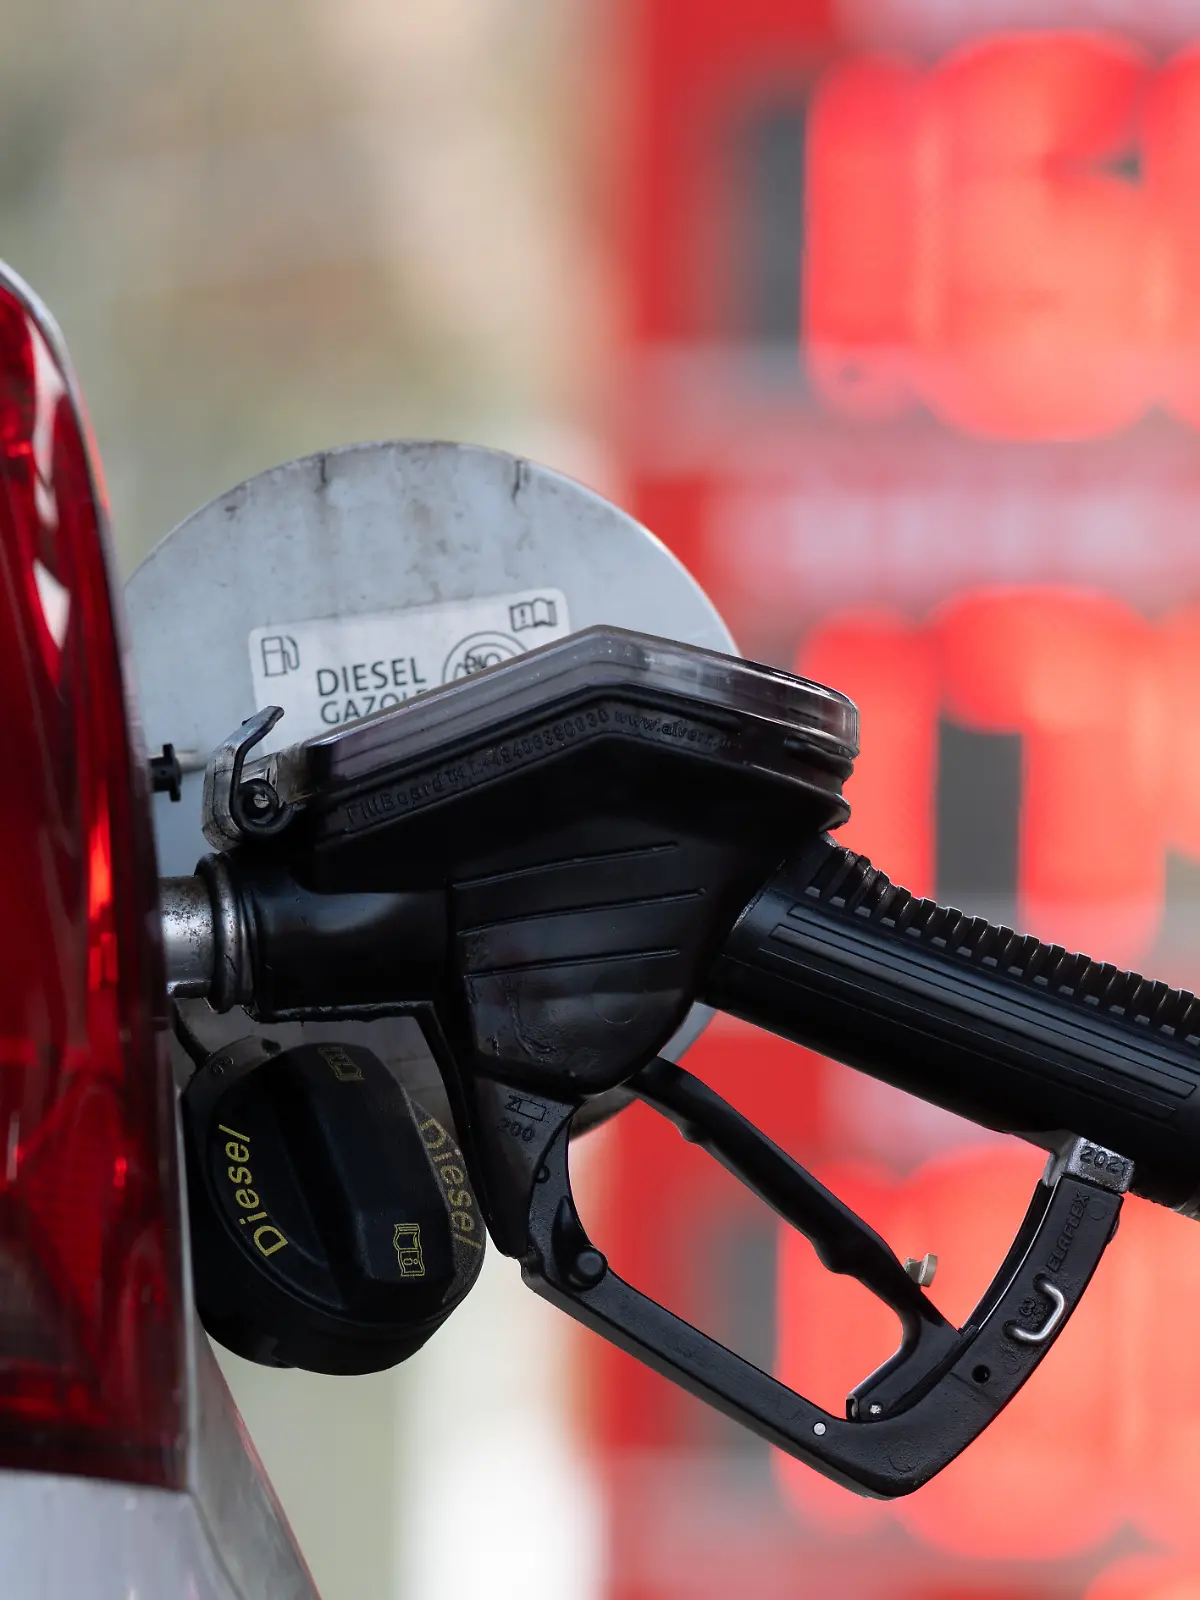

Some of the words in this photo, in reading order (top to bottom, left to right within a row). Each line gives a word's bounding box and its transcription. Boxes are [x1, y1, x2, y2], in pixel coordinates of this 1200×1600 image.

[316, 657, 427, 697] DIESEL
[320, 688, 429, 725] GAZO
[219, 1123, 289, 1257] Diesel
[419, 1118, 482, 1250] Diesel
[1046, 1190, 1090, 1272] ELAFLEX
